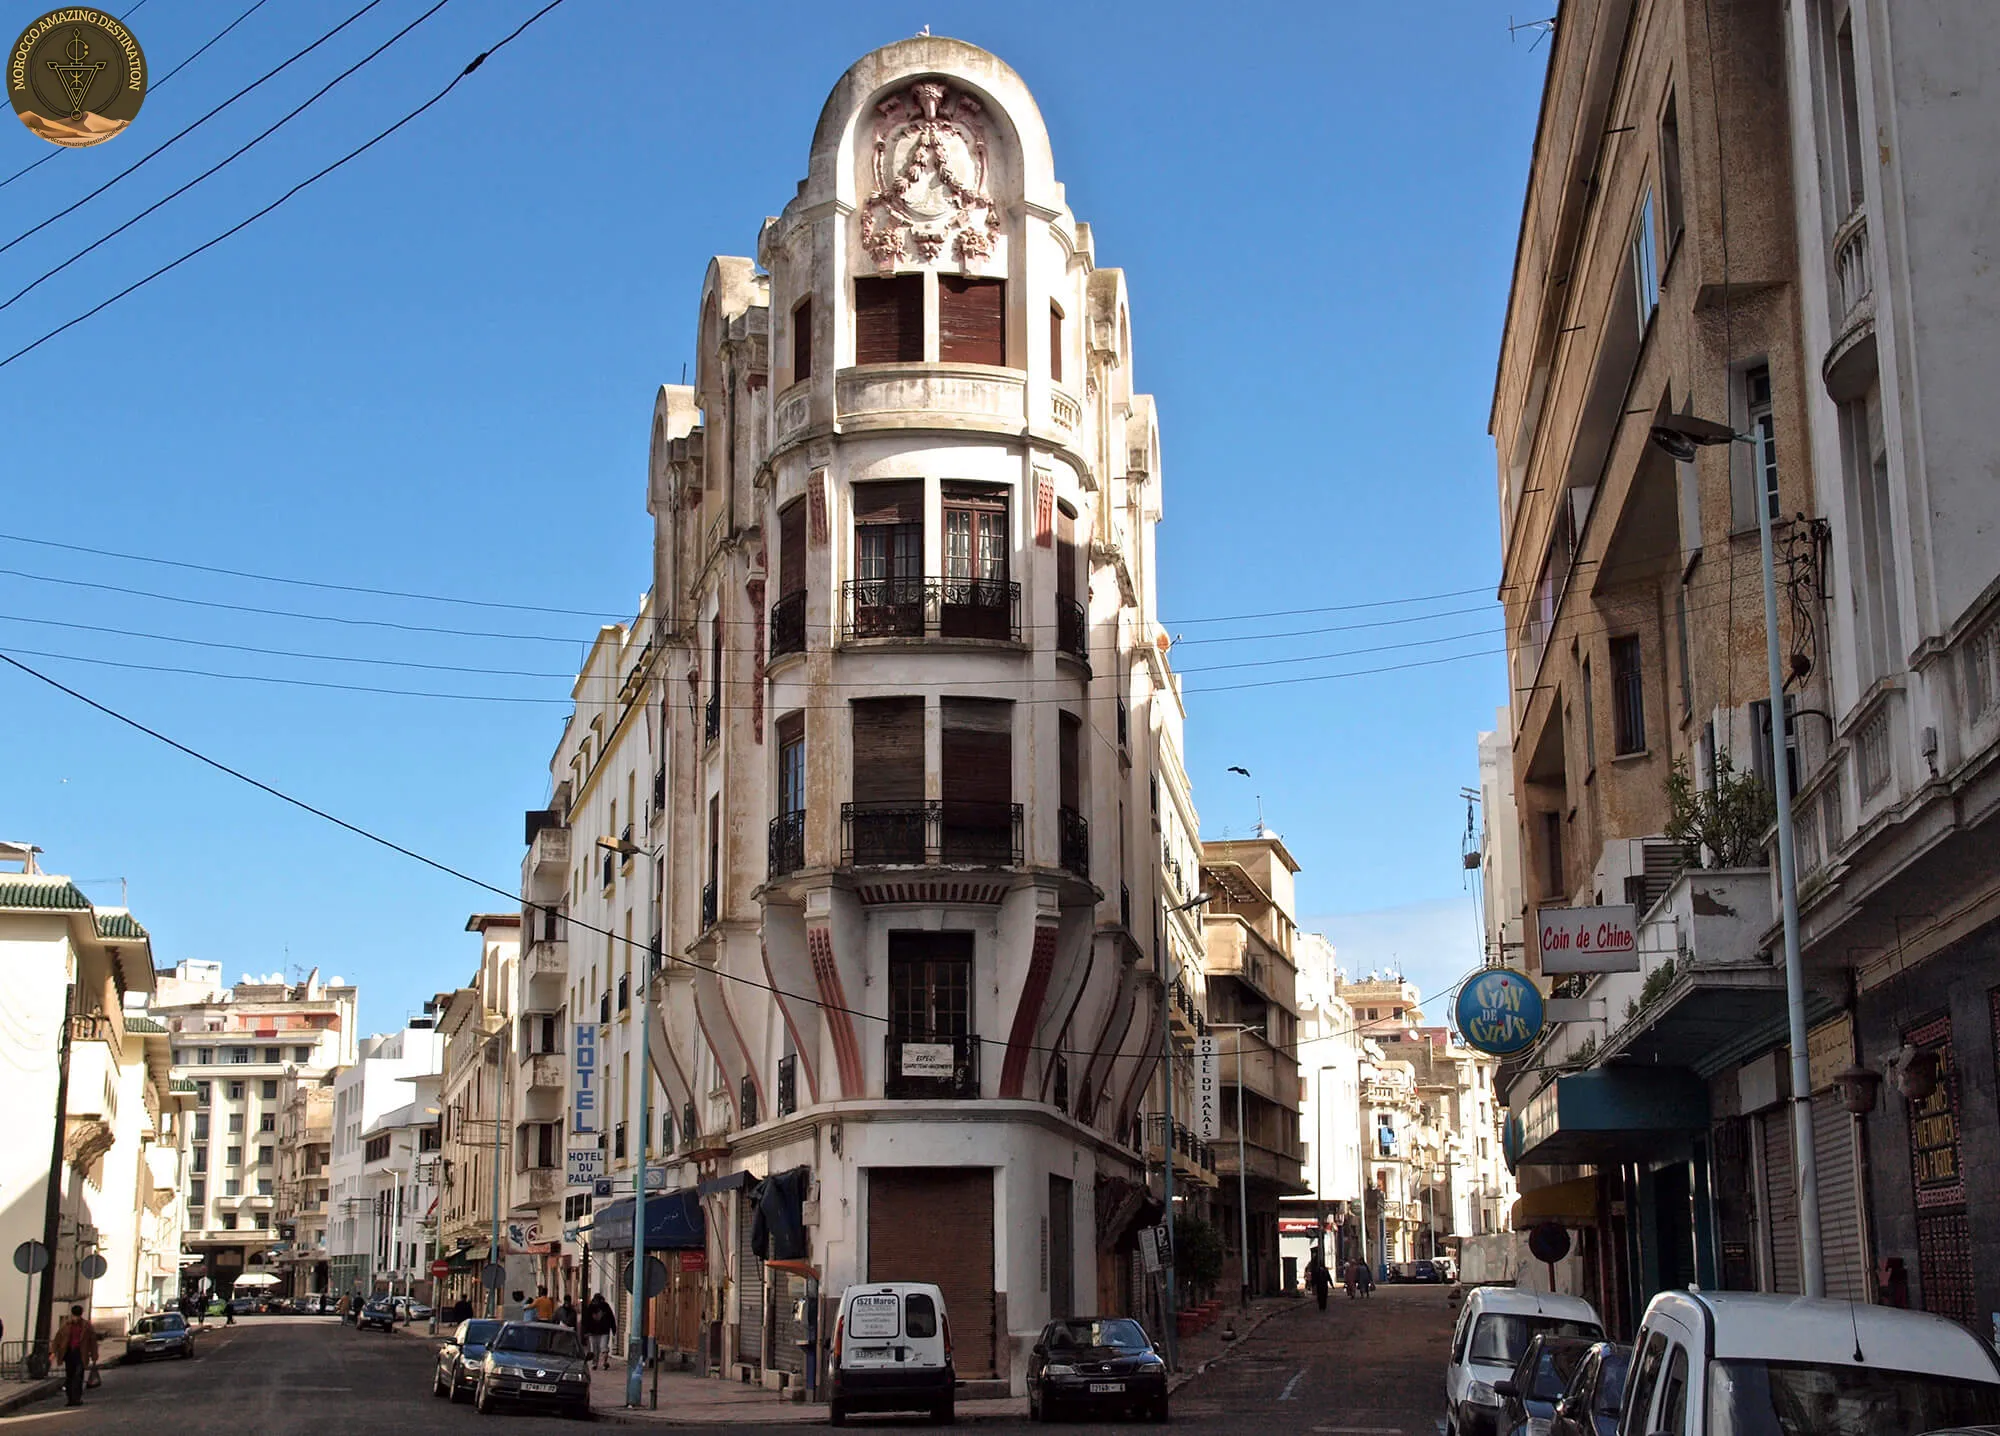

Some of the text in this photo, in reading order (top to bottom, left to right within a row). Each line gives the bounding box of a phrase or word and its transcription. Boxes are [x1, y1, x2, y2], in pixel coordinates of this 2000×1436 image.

[1543, 921, 1633, 951] Coin de Chine
[1482, 1009, 1498, 1021] DE
[576, 1026, 595, 1132] HOTEL
[1201, 1039, 1212, 1138] HOTEL DU PALAIS
[568, 1152, 603, 1161] HOTEL
[579, 1163, 593, 1172] DU
[873, 1297, 896, 1305] Maroc
